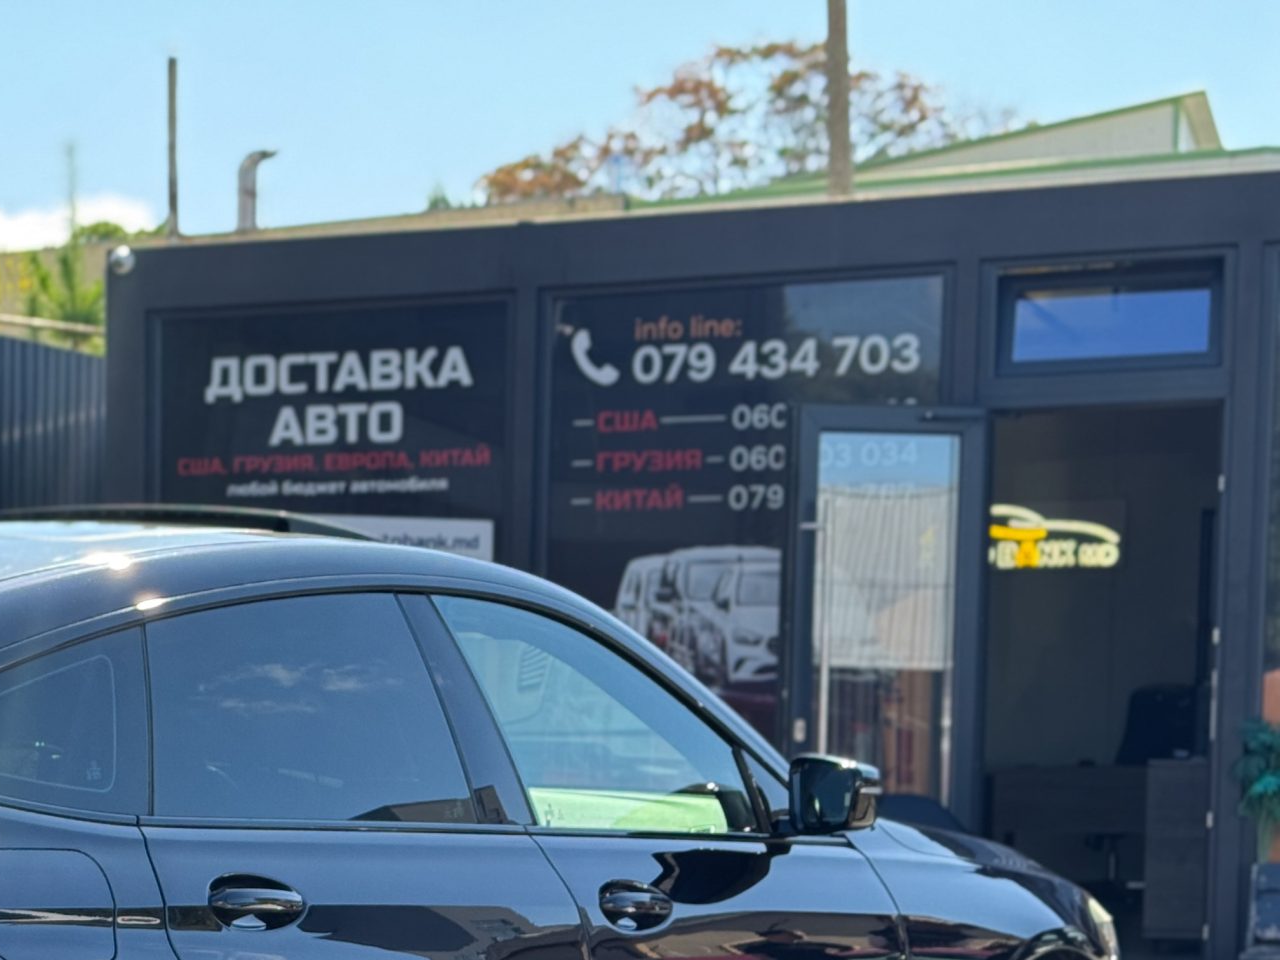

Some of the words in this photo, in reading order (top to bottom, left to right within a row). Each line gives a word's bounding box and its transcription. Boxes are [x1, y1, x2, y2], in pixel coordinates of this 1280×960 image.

[634, 317, 684, 341] info
[691, 317, 742, 339] line:
[632, 343, 716, 384] 079
[729, 339, 820, 381] 434
[833, 333, 921, 377] 703
[204, 346, 473, 404] ДОСТАВКА
[268, 401, 404, 447] АВТО
[597, 410, 659, 433] США
[419, 443, 491, 468] КИТАЙ
[596, 449, 703, 473] ГРУЗИЯ
[226, 479, 278, 498] любой
[281, 477, 347, 496] бюджет
[350, 475, 450, 494] автомобиля
[595, 485, 684, 511] КИТАЙ
[728, 484, 786, 511] 079
